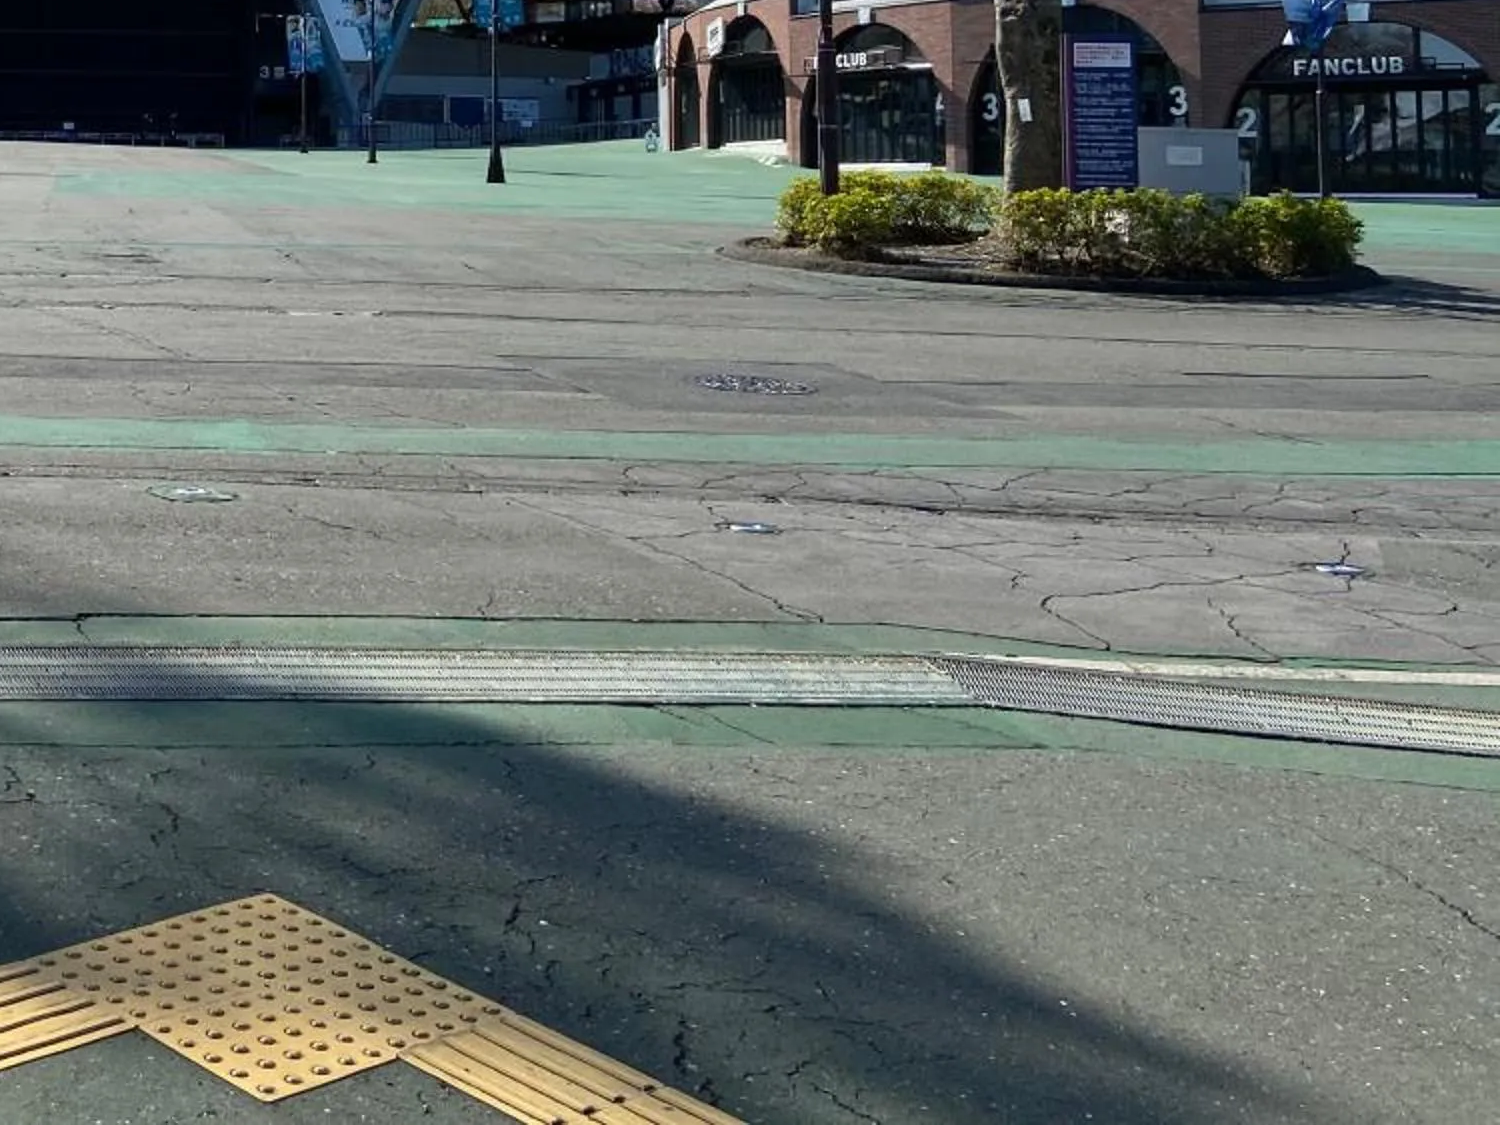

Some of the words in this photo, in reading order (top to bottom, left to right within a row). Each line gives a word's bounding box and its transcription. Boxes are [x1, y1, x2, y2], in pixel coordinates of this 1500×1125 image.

[1293, 56, 1404, 76] FANCLUB
[1169, 85, 1189, 116] 3
[1235, 106, 1258, 137] 2
